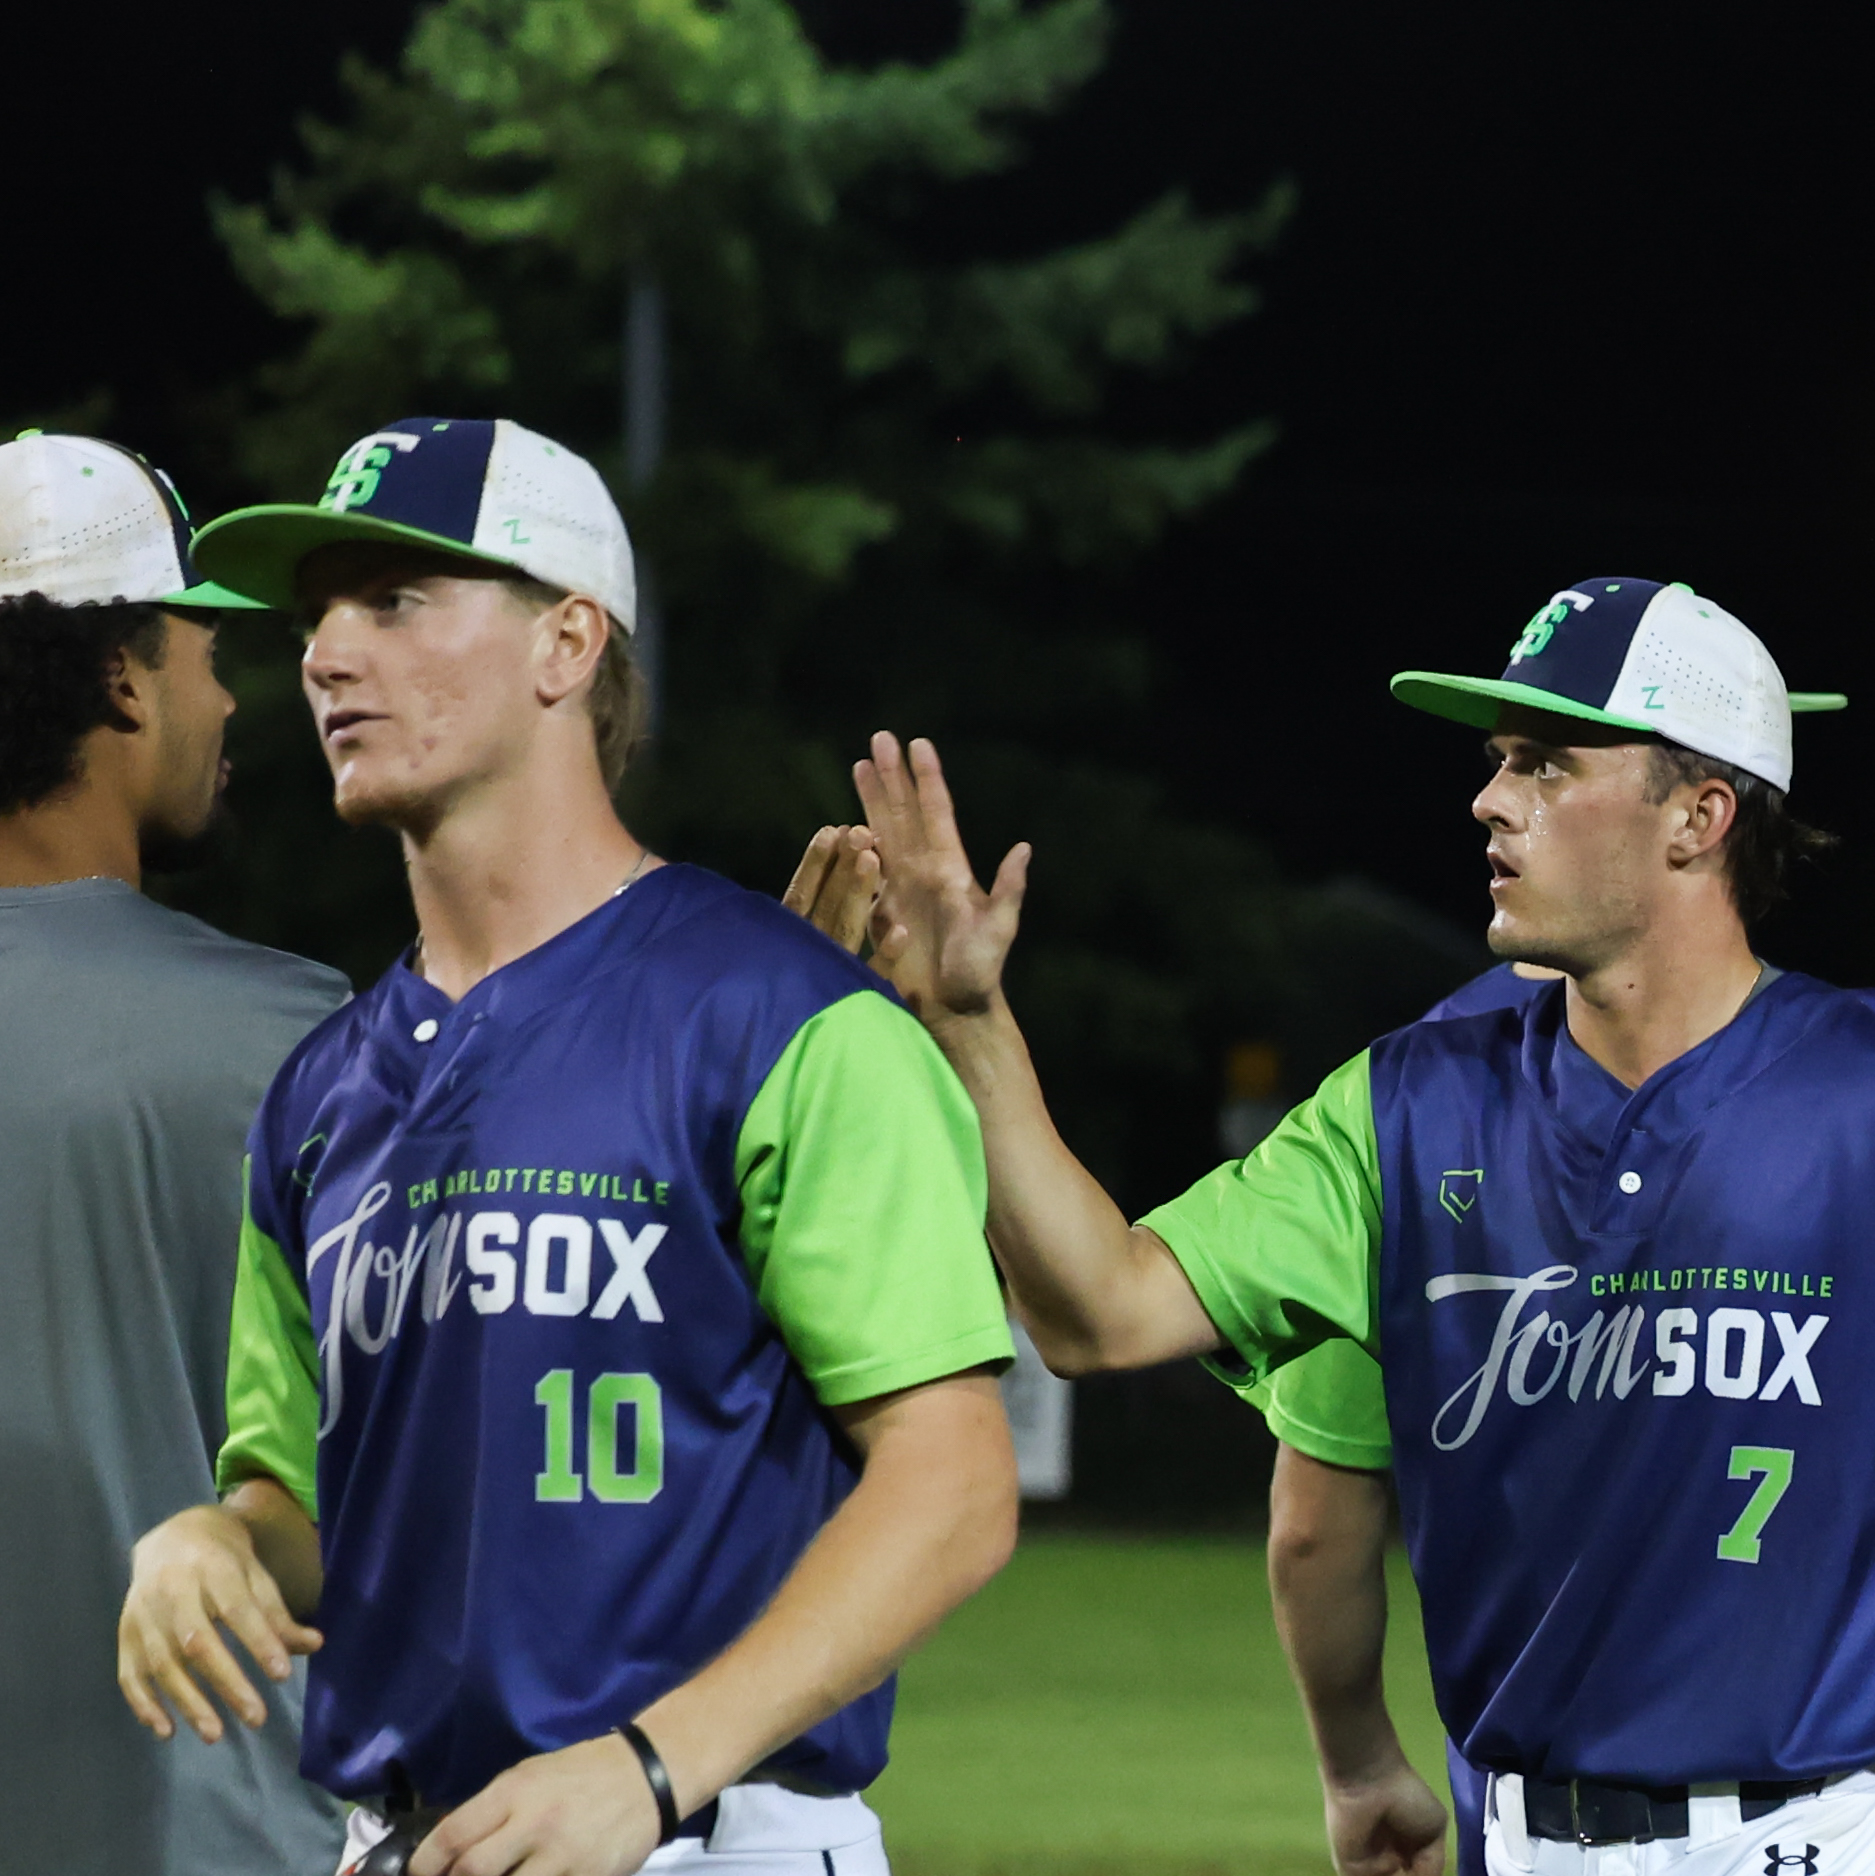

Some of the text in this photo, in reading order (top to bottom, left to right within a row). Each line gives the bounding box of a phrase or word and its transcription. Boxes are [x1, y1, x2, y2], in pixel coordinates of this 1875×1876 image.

[406, 1166, 671, 1210] CHARLOTTESVILLE
[1590, 1266, 1834, 1299] CHARLOTTESVILLE
[534, 1367, 666, 1504] 10
[1715, 1445, 1796, 1565] 7
